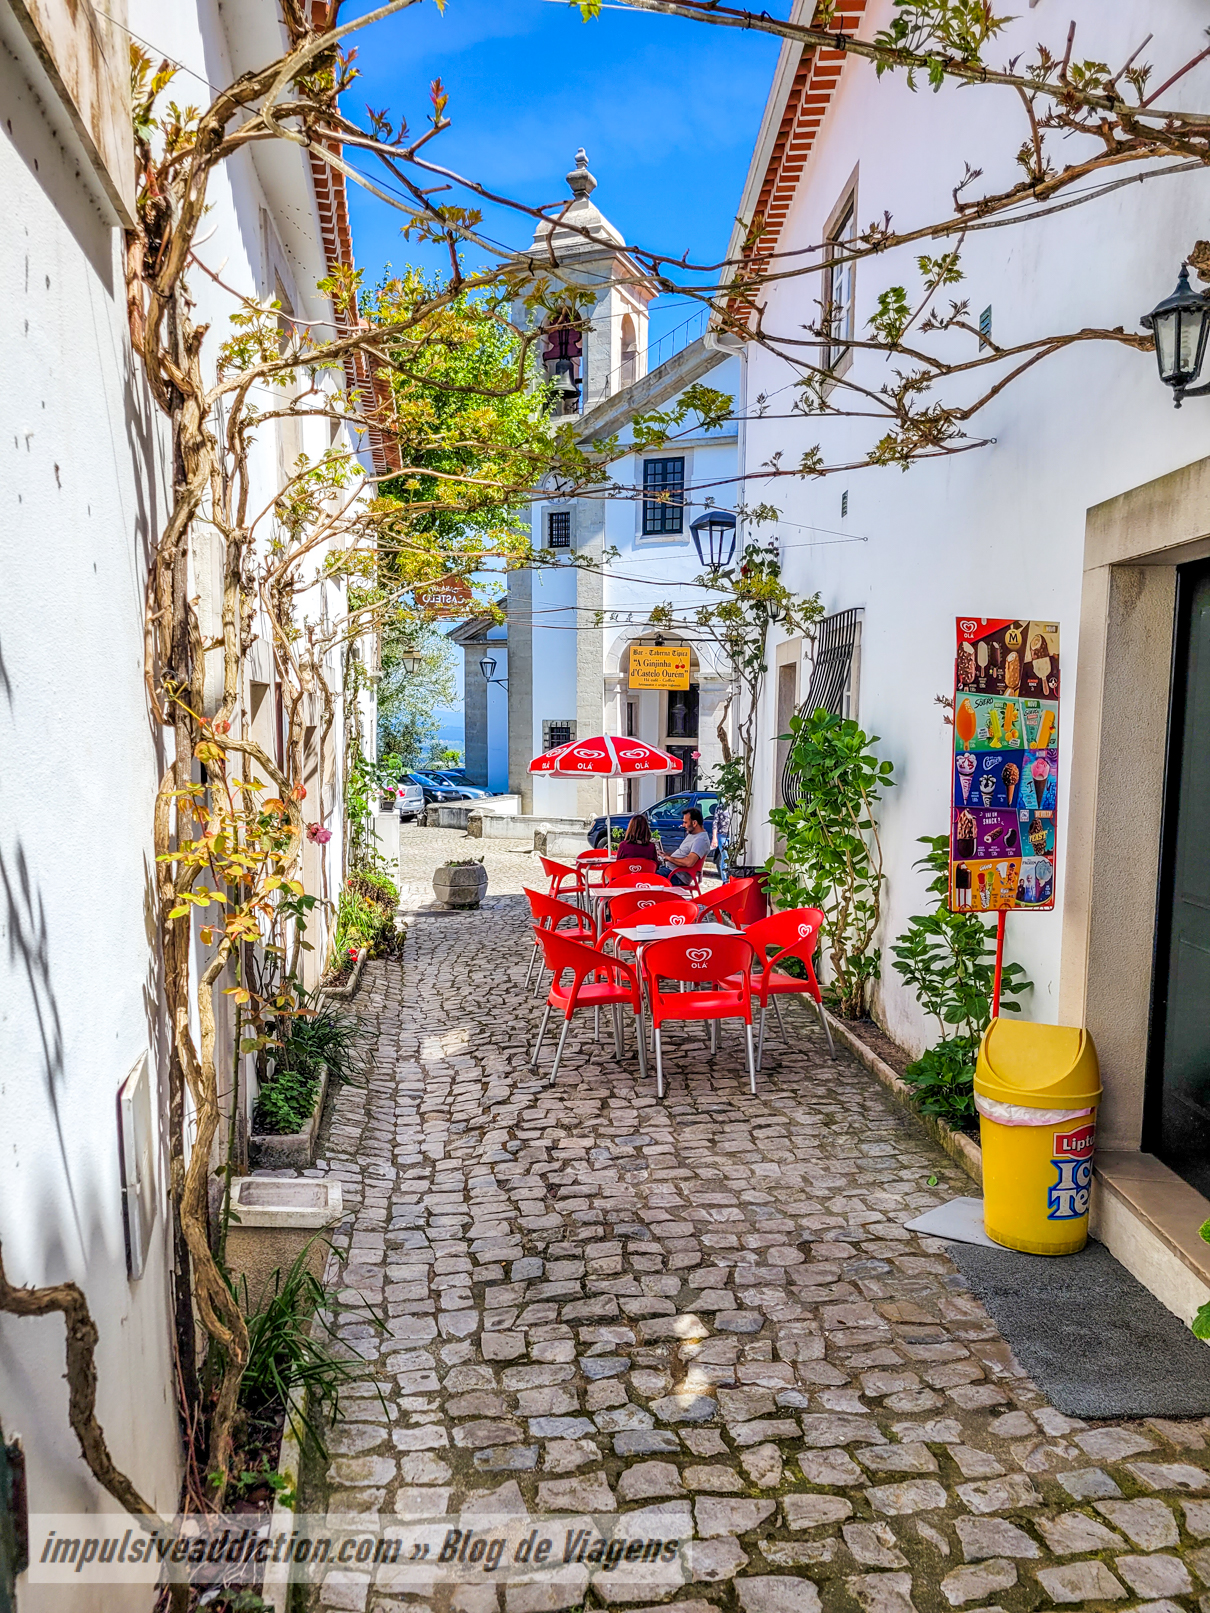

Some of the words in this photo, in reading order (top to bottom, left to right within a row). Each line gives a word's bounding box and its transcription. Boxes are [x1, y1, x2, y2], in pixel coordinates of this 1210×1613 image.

[643, 658, 672, 668] Ginjinha
[577, 761, 593, 770] OLÁ
[635, 760, 649, 769] OLÁ
[691, 960, 708, 969] OLÁ
[1056, 1162, 1092, 1189] Ic
[1051, 1189, 1090, 1217] Te
